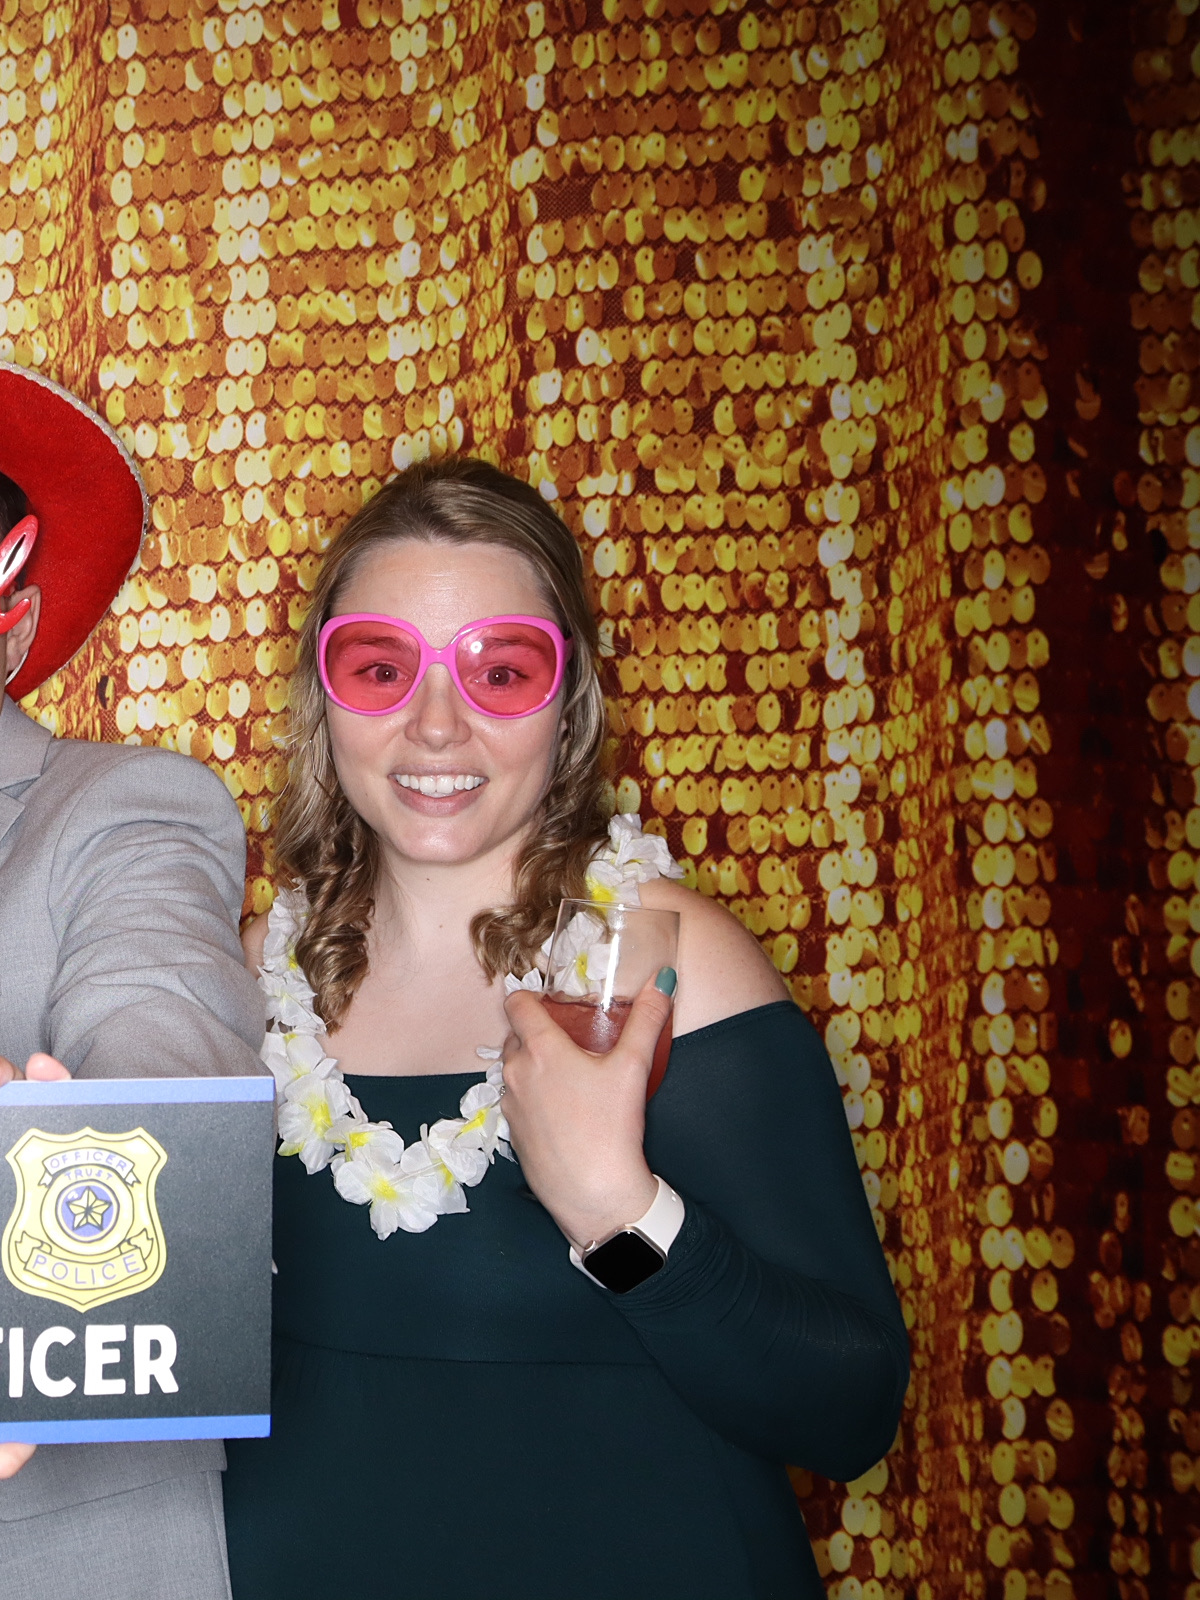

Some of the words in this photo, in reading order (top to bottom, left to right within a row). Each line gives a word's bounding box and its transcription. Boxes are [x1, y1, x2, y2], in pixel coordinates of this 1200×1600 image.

[50, 1150, 127, 1172] OFFICER
[64, 1168, 113, 1181] TRUST
[32, 1253, 140, 1285] POLICE
